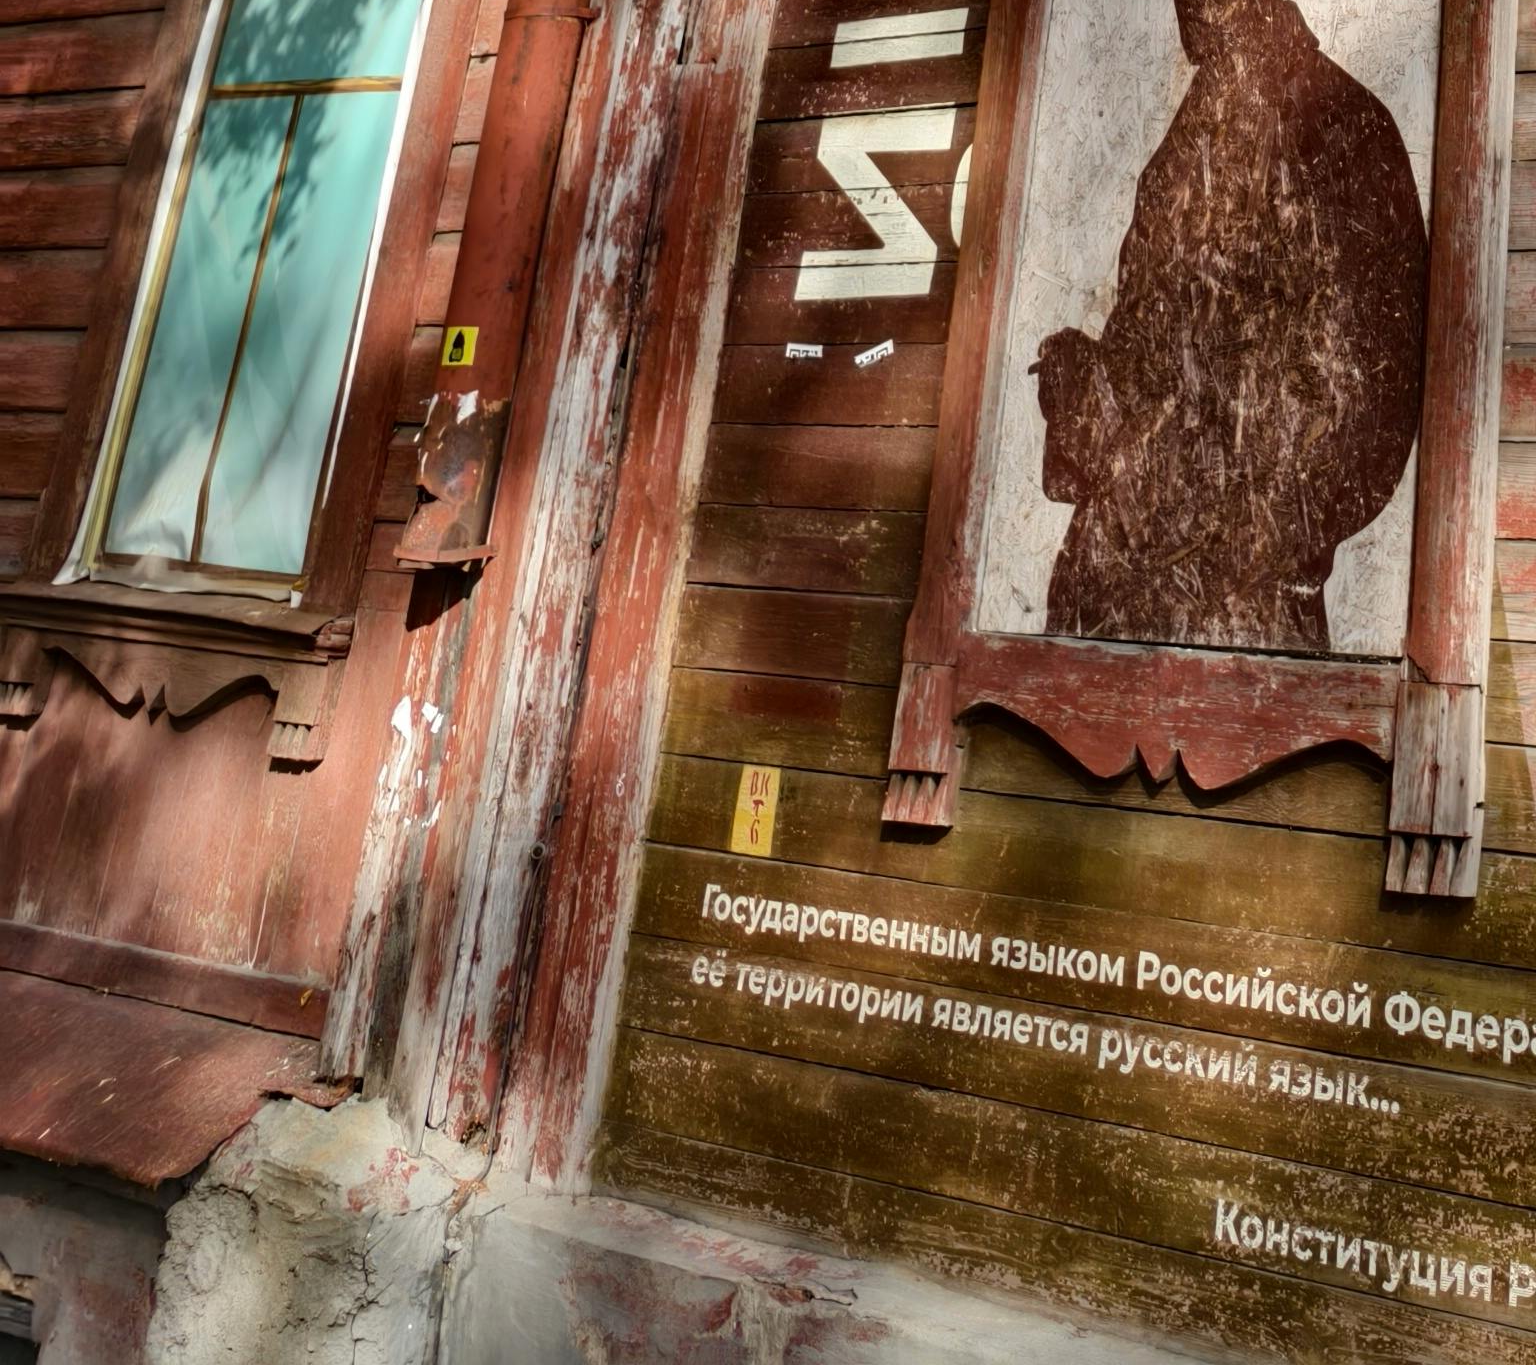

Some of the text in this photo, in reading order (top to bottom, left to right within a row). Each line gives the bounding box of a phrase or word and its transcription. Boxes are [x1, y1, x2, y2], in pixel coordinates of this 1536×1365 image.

[691, 949, 728, 987] её
[735, 960, 924, 1023] территории
[932, 998, 1090, 1055] является
[1097, 1027, 1258, 1087] русский
[701, 883, 981, 963] Государственным
[990, 937, 1125, 987] языком
[1137, 950, 1372, 1028] Российской
[1214, 1198, 1493, 1302] Конституция
